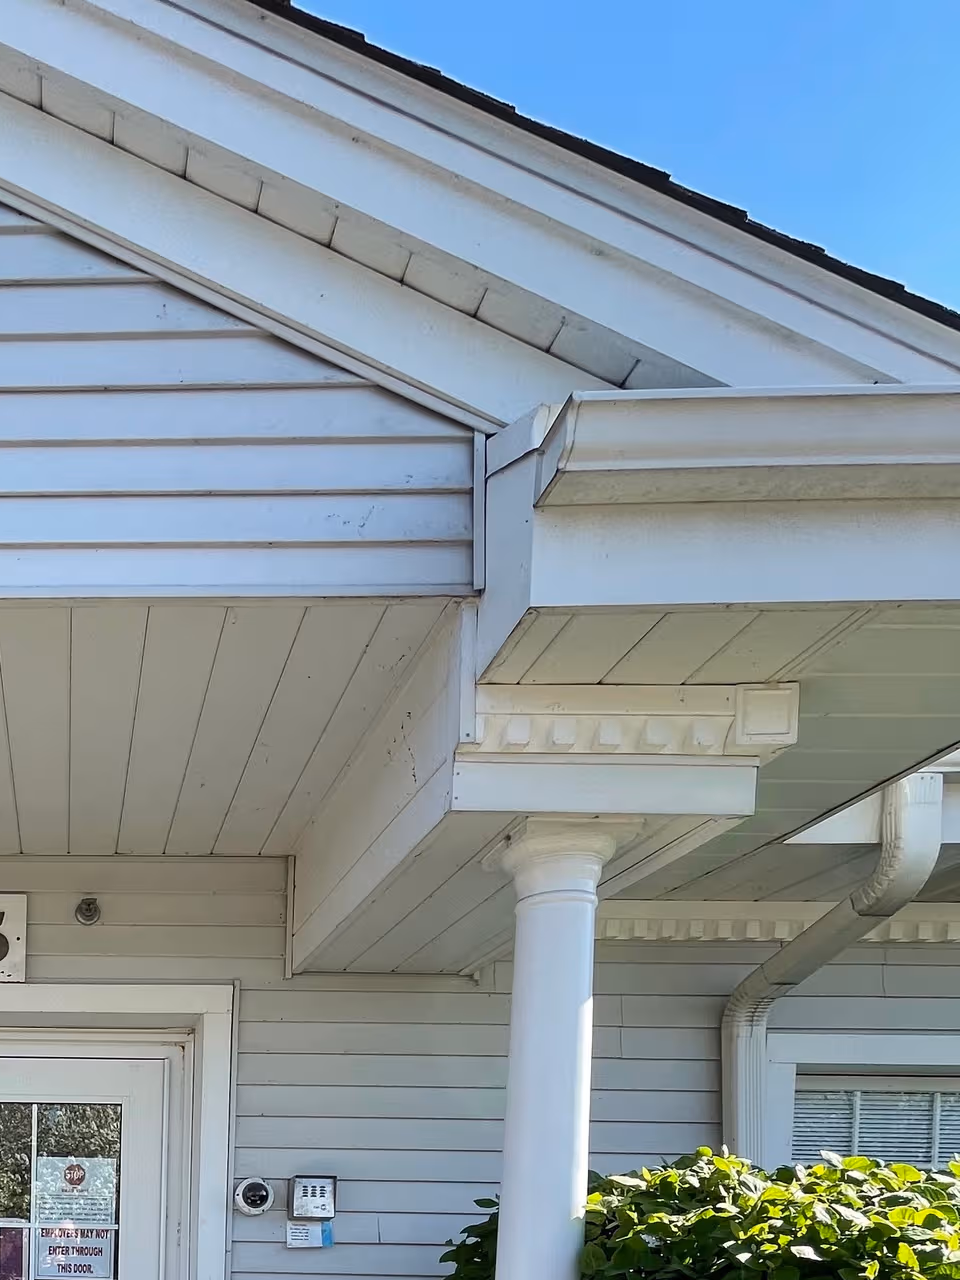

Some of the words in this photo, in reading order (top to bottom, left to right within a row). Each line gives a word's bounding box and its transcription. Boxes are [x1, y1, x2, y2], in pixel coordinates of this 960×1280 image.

[65, 1170, 85, 1180] STOP
[40, 1228, 79, 1238] EMPLOYEES
[80, 1229, 93, 1239] MAY
[95, 1229, 110, 1239] NOT
[48, 1246, 70, 1255] ENTER
[71, 1246, 103, 1256] THROUGH
[57, 1263, 72, 1274] THIS
[73, 1264, 94, 1274] DOOR.
